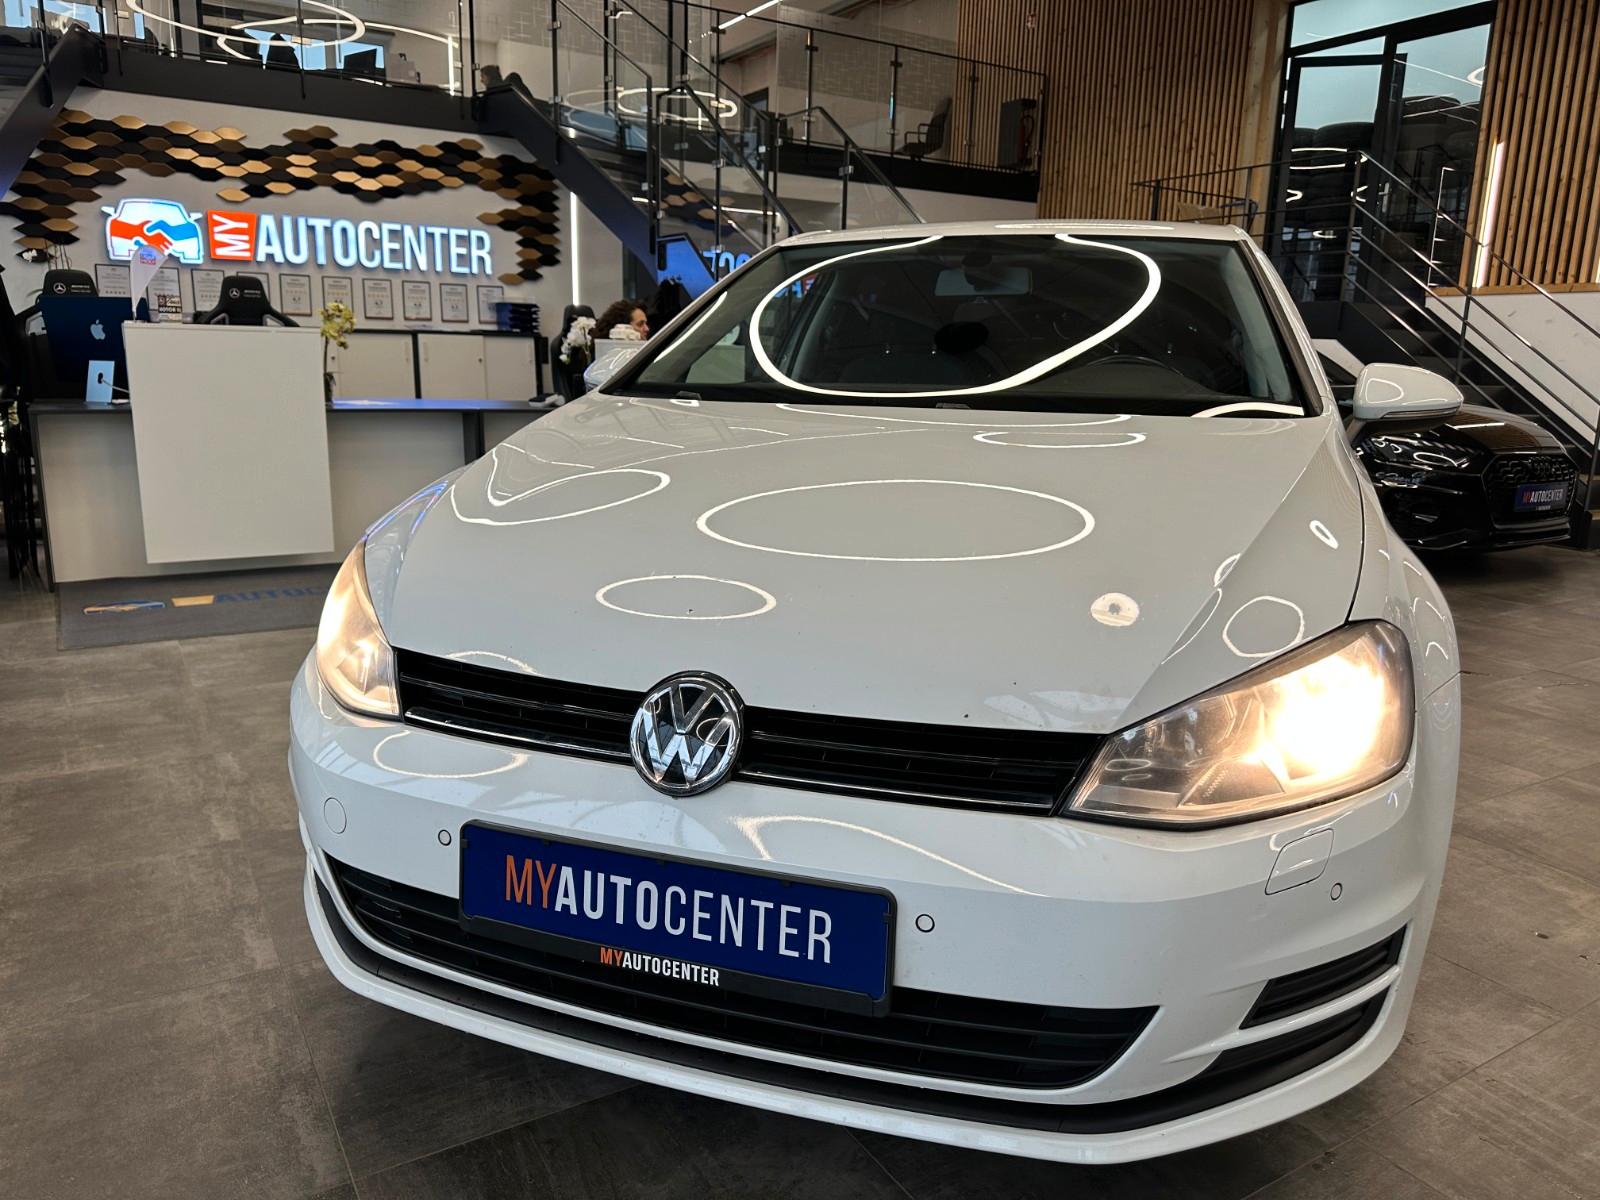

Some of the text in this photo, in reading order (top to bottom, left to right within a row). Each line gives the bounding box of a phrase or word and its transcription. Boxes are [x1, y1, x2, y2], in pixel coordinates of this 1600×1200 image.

[212, 213, 493, 275] MY AUTOCENTER
[215, 588, 326, 603] AUTOC
[505, 854, 832, 964] MYAUTOCENTER
[600, 946, 719, 987] MYAUTOCENTER
